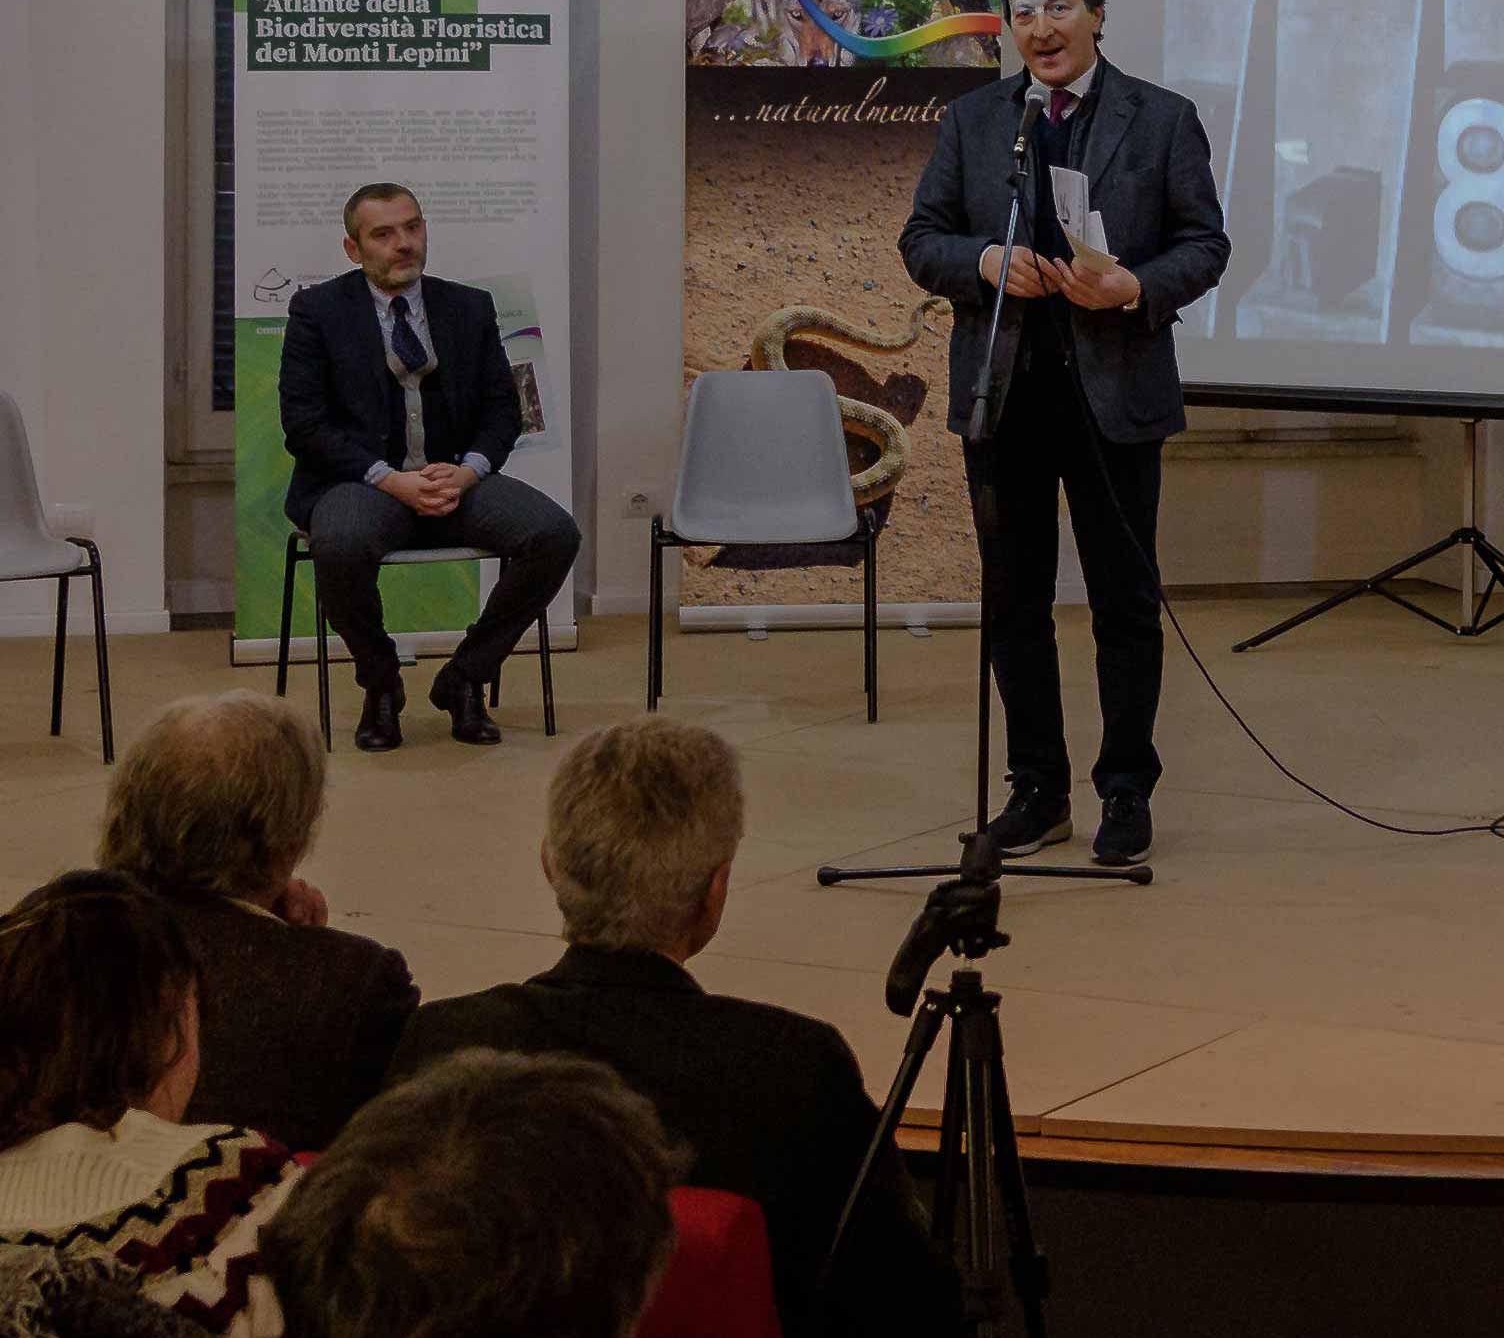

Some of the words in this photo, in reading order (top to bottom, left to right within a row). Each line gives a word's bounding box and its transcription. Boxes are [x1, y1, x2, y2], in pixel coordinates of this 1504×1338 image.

[255, 16, 416, 39] Biodiversità
[421, 17, 545, 40] Floristica
[256, 41, 297, 64] dei
[302, 41, 380, 64] Monti
